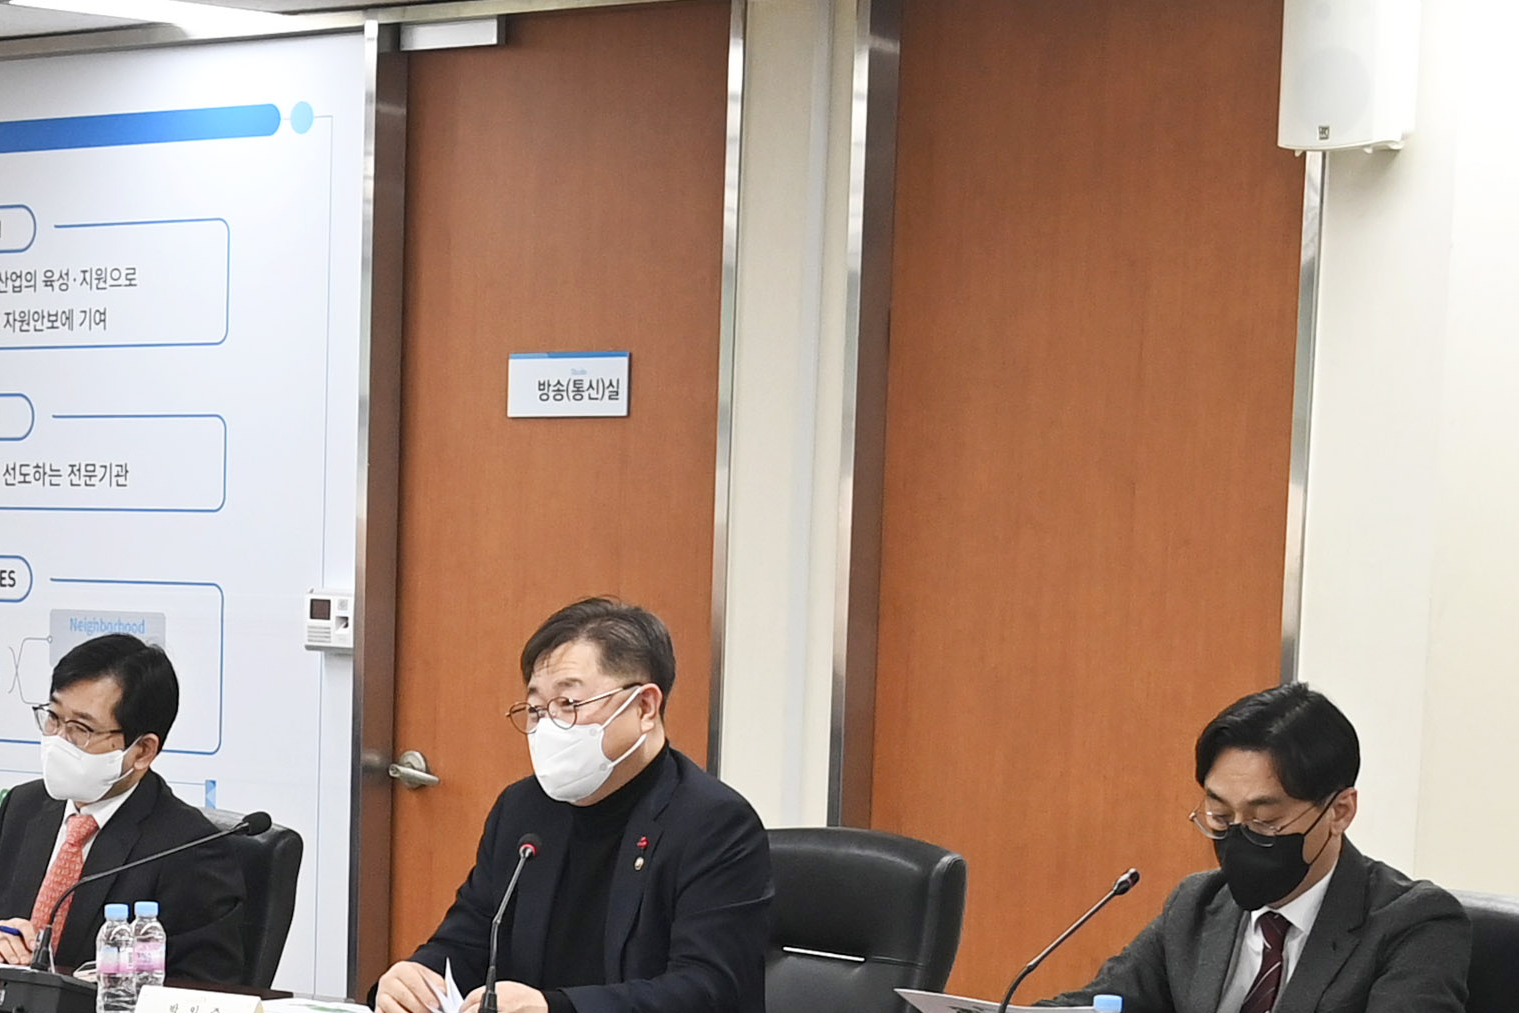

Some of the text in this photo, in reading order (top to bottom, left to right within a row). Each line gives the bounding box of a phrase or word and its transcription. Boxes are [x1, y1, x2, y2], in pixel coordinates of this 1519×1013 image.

[4, 309, 73, 332] 자원안보에
[80, 308, 106, 330] 기여
[538, 378, 619, 401] 방송(통신)실
[3, 463, 62, 486] 선도하는
[68, 463, 129, 487] 전문기관
[69, 616, 146, 636] Neighborhood
